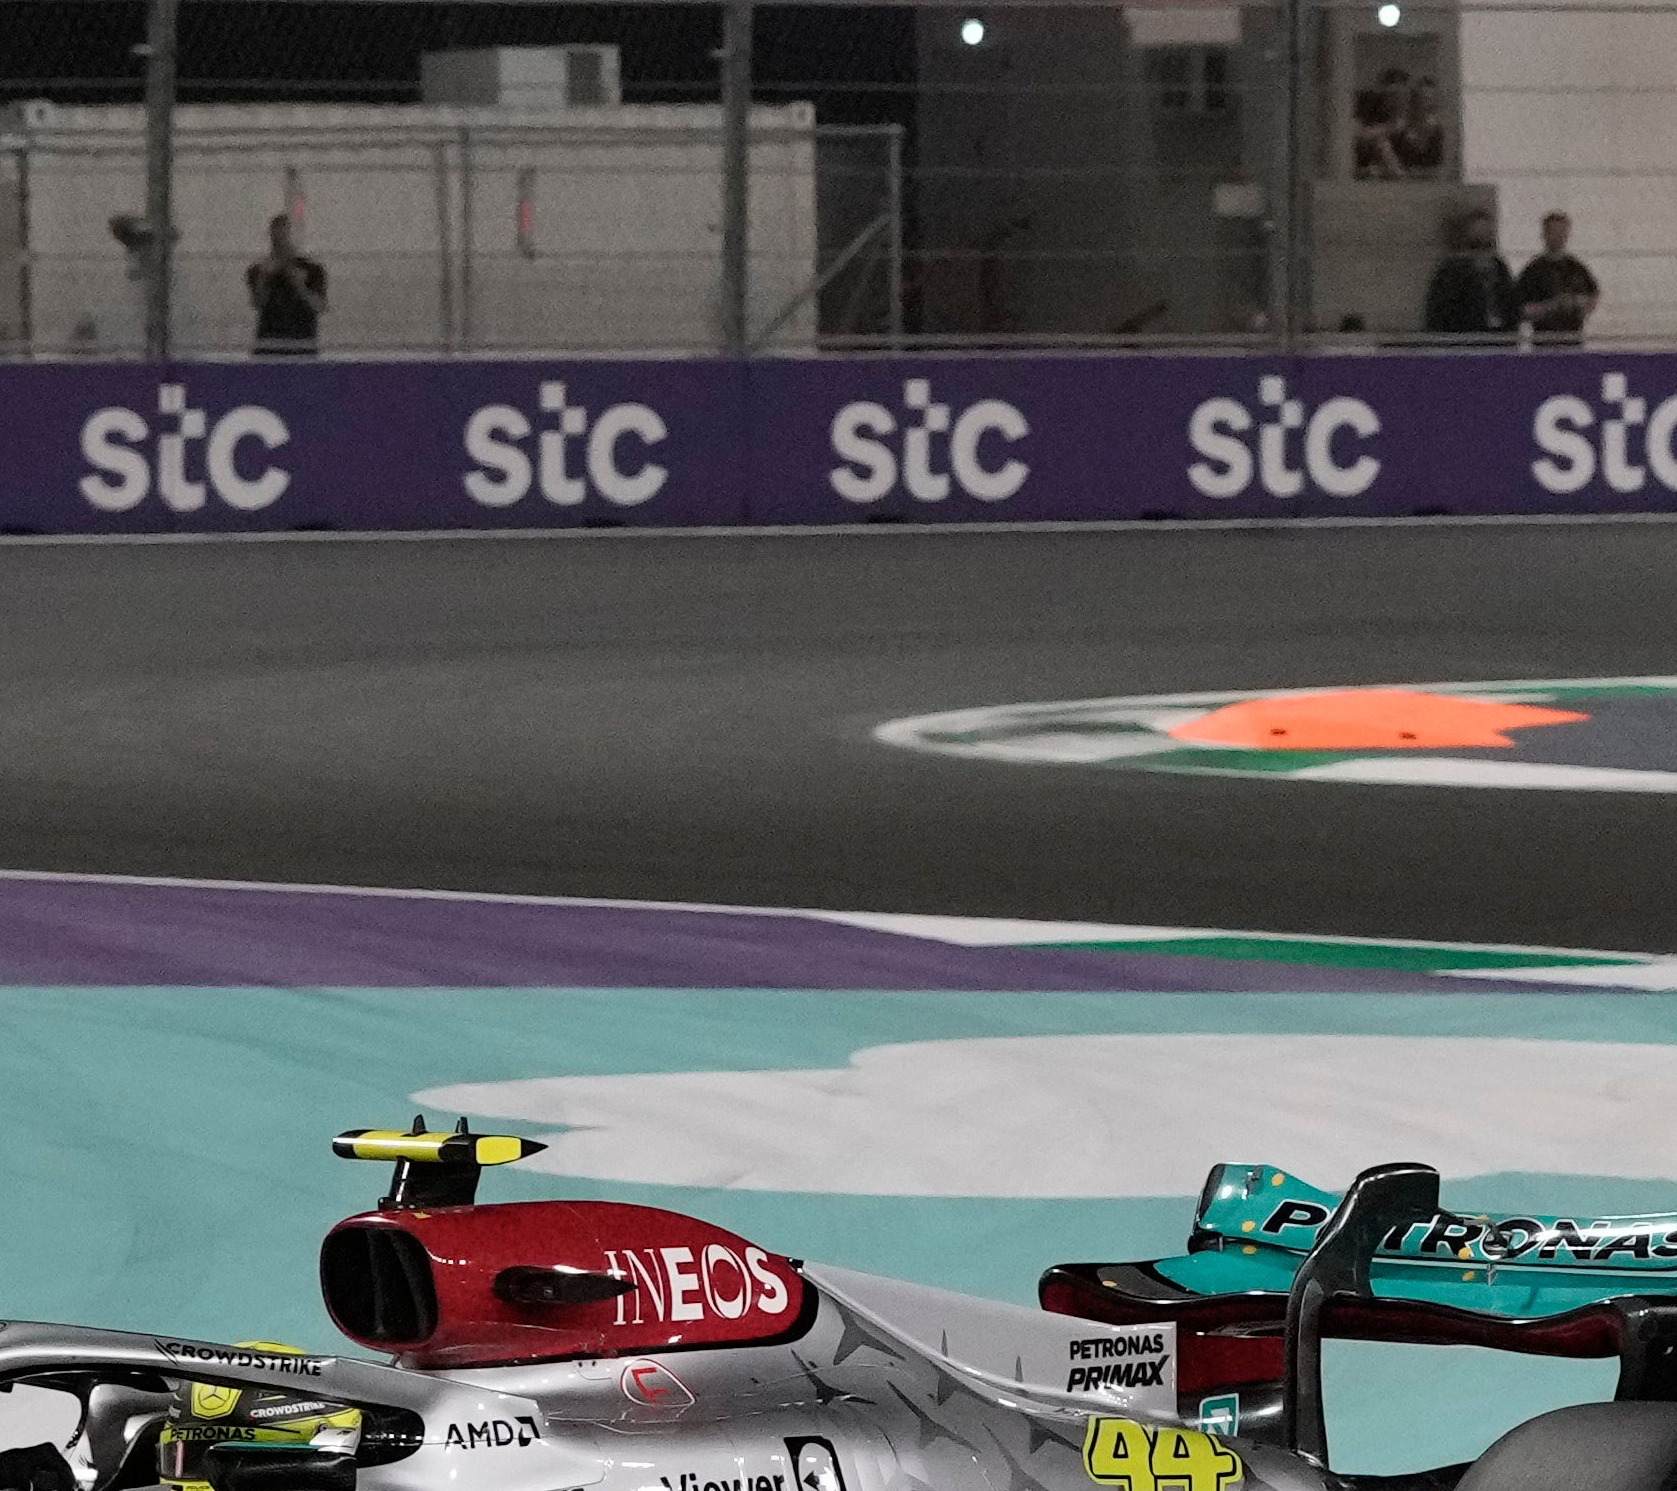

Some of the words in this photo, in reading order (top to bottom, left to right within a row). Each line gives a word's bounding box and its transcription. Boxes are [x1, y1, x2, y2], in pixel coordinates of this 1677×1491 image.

[81, 386, 288, 510] stc
[465, 383, 665, 505] stc
[831, 380, 1027, 501] stc
[1189, 377, 1379, 496] stc
[604, 1242, 789, 1327] INEOS
[166, 1341, 323, 1378] CROWDSTRIKE
[1066, 1353, 1172, 1394] PRIMAX
[1069, 1333, 1165, 1362] PETRONAS
[170, 1425, 256, 1441] PETRONAS
[444, 1419, 514, 1452] AMD
